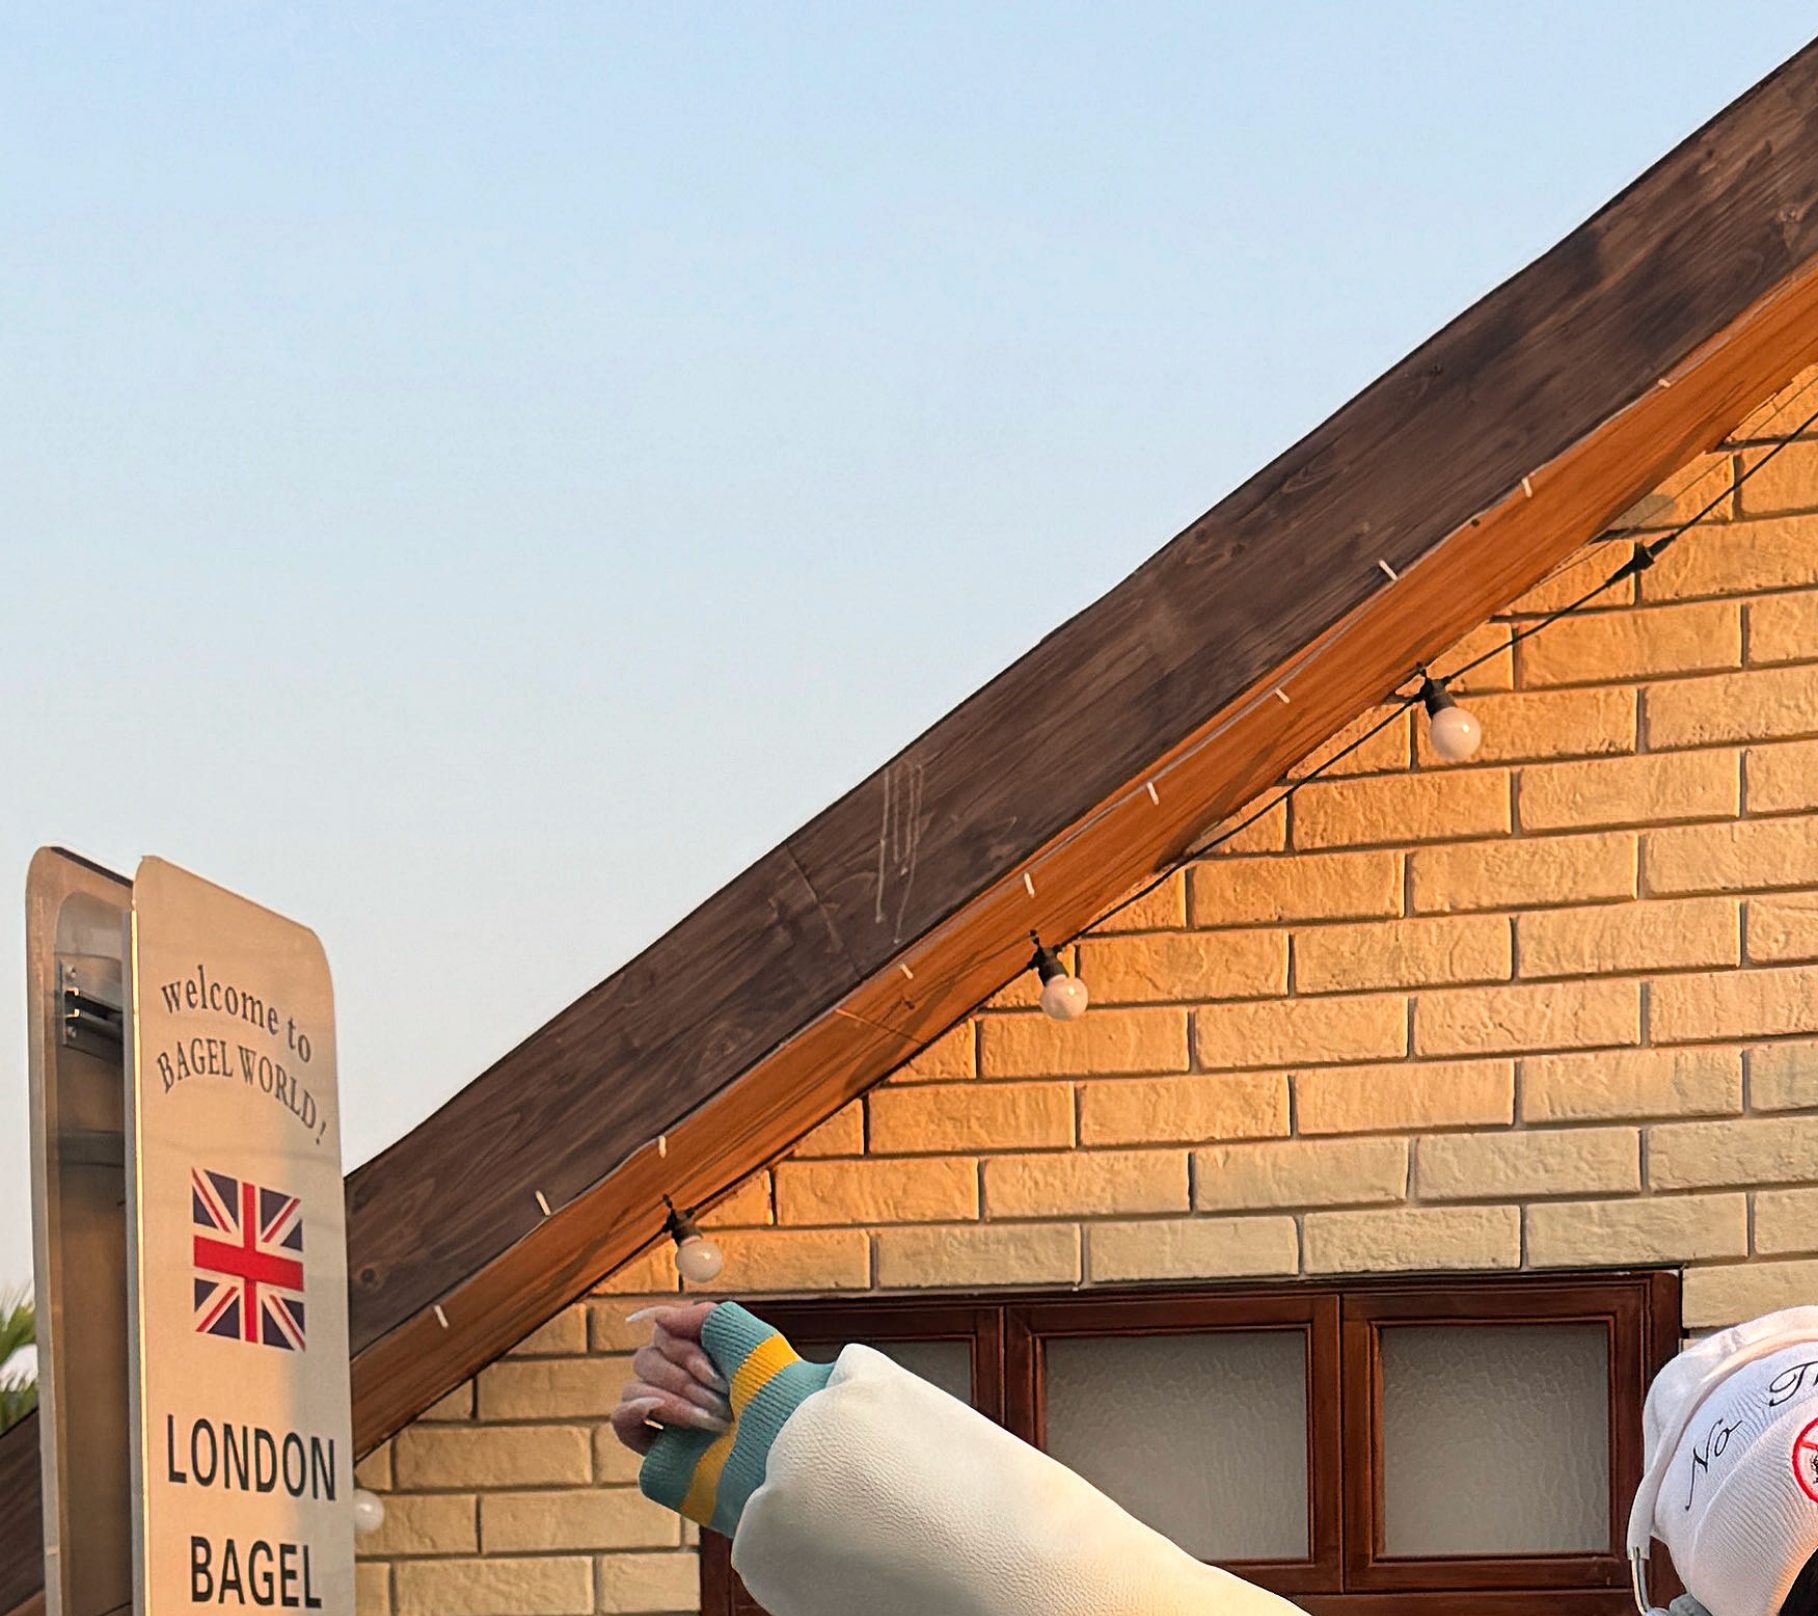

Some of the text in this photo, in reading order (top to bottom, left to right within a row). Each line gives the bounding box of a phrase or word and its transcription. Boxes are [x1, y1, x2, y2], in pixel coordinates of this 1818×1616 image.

[161, 963, 312, 1064] welcome to
[157, 1037, 327, 1145] BAGEL WORLD!
[167, 1413, 337, 1501] LONDON
[1685, 1416, 1744, 1512] No
[190, 1534, 322, 1609] BAGEL
